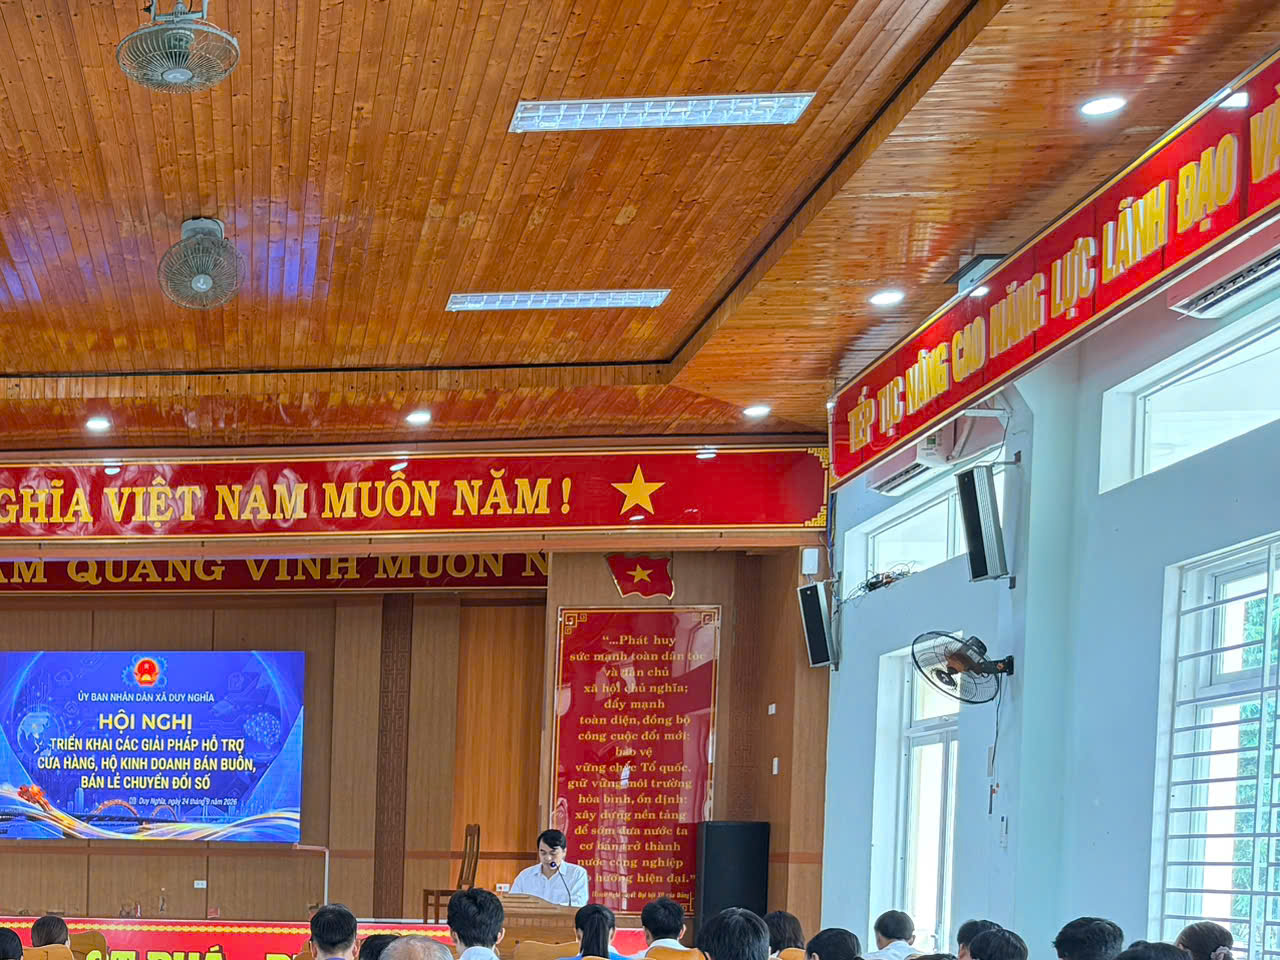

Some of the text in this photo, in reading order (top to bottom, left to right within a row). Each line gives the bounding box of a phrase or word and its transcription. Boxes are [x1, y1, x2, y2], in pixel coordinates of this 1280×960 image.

[102, 473, 204, 532] VIỆT
[214, 482, 308, 521] NAM
[321, 469, 438, 519] MUÔN
[453, 468, 551, 517] NĂM
[66, 559, 225, 585] QUANG
[245, 556, 360, 581] VINH
[77, 690, 215, 703] ỦY BAN NHÂN DÂN XÃ DUY NGHĨA
[99, 708, 193, 735] HỘI NGHỊ
[50, 733, 245, 755] TRIỂN KHAI CÁC GIẢI PHÁP HỖ TRỢ
[63, 753, 98, 772] HÀNG,
[101, 754, 118, 773] HỘ
[120, 757, 148, 770] KINH
[151, 757, 191, 770] DOANH
[194, 754, 218, 771] BÁN
[221, 755, 257, 773] BUÔN,
[81, 772, 211, 790] BÁN LẺ CHUYỂN ĐỔI SỐ
